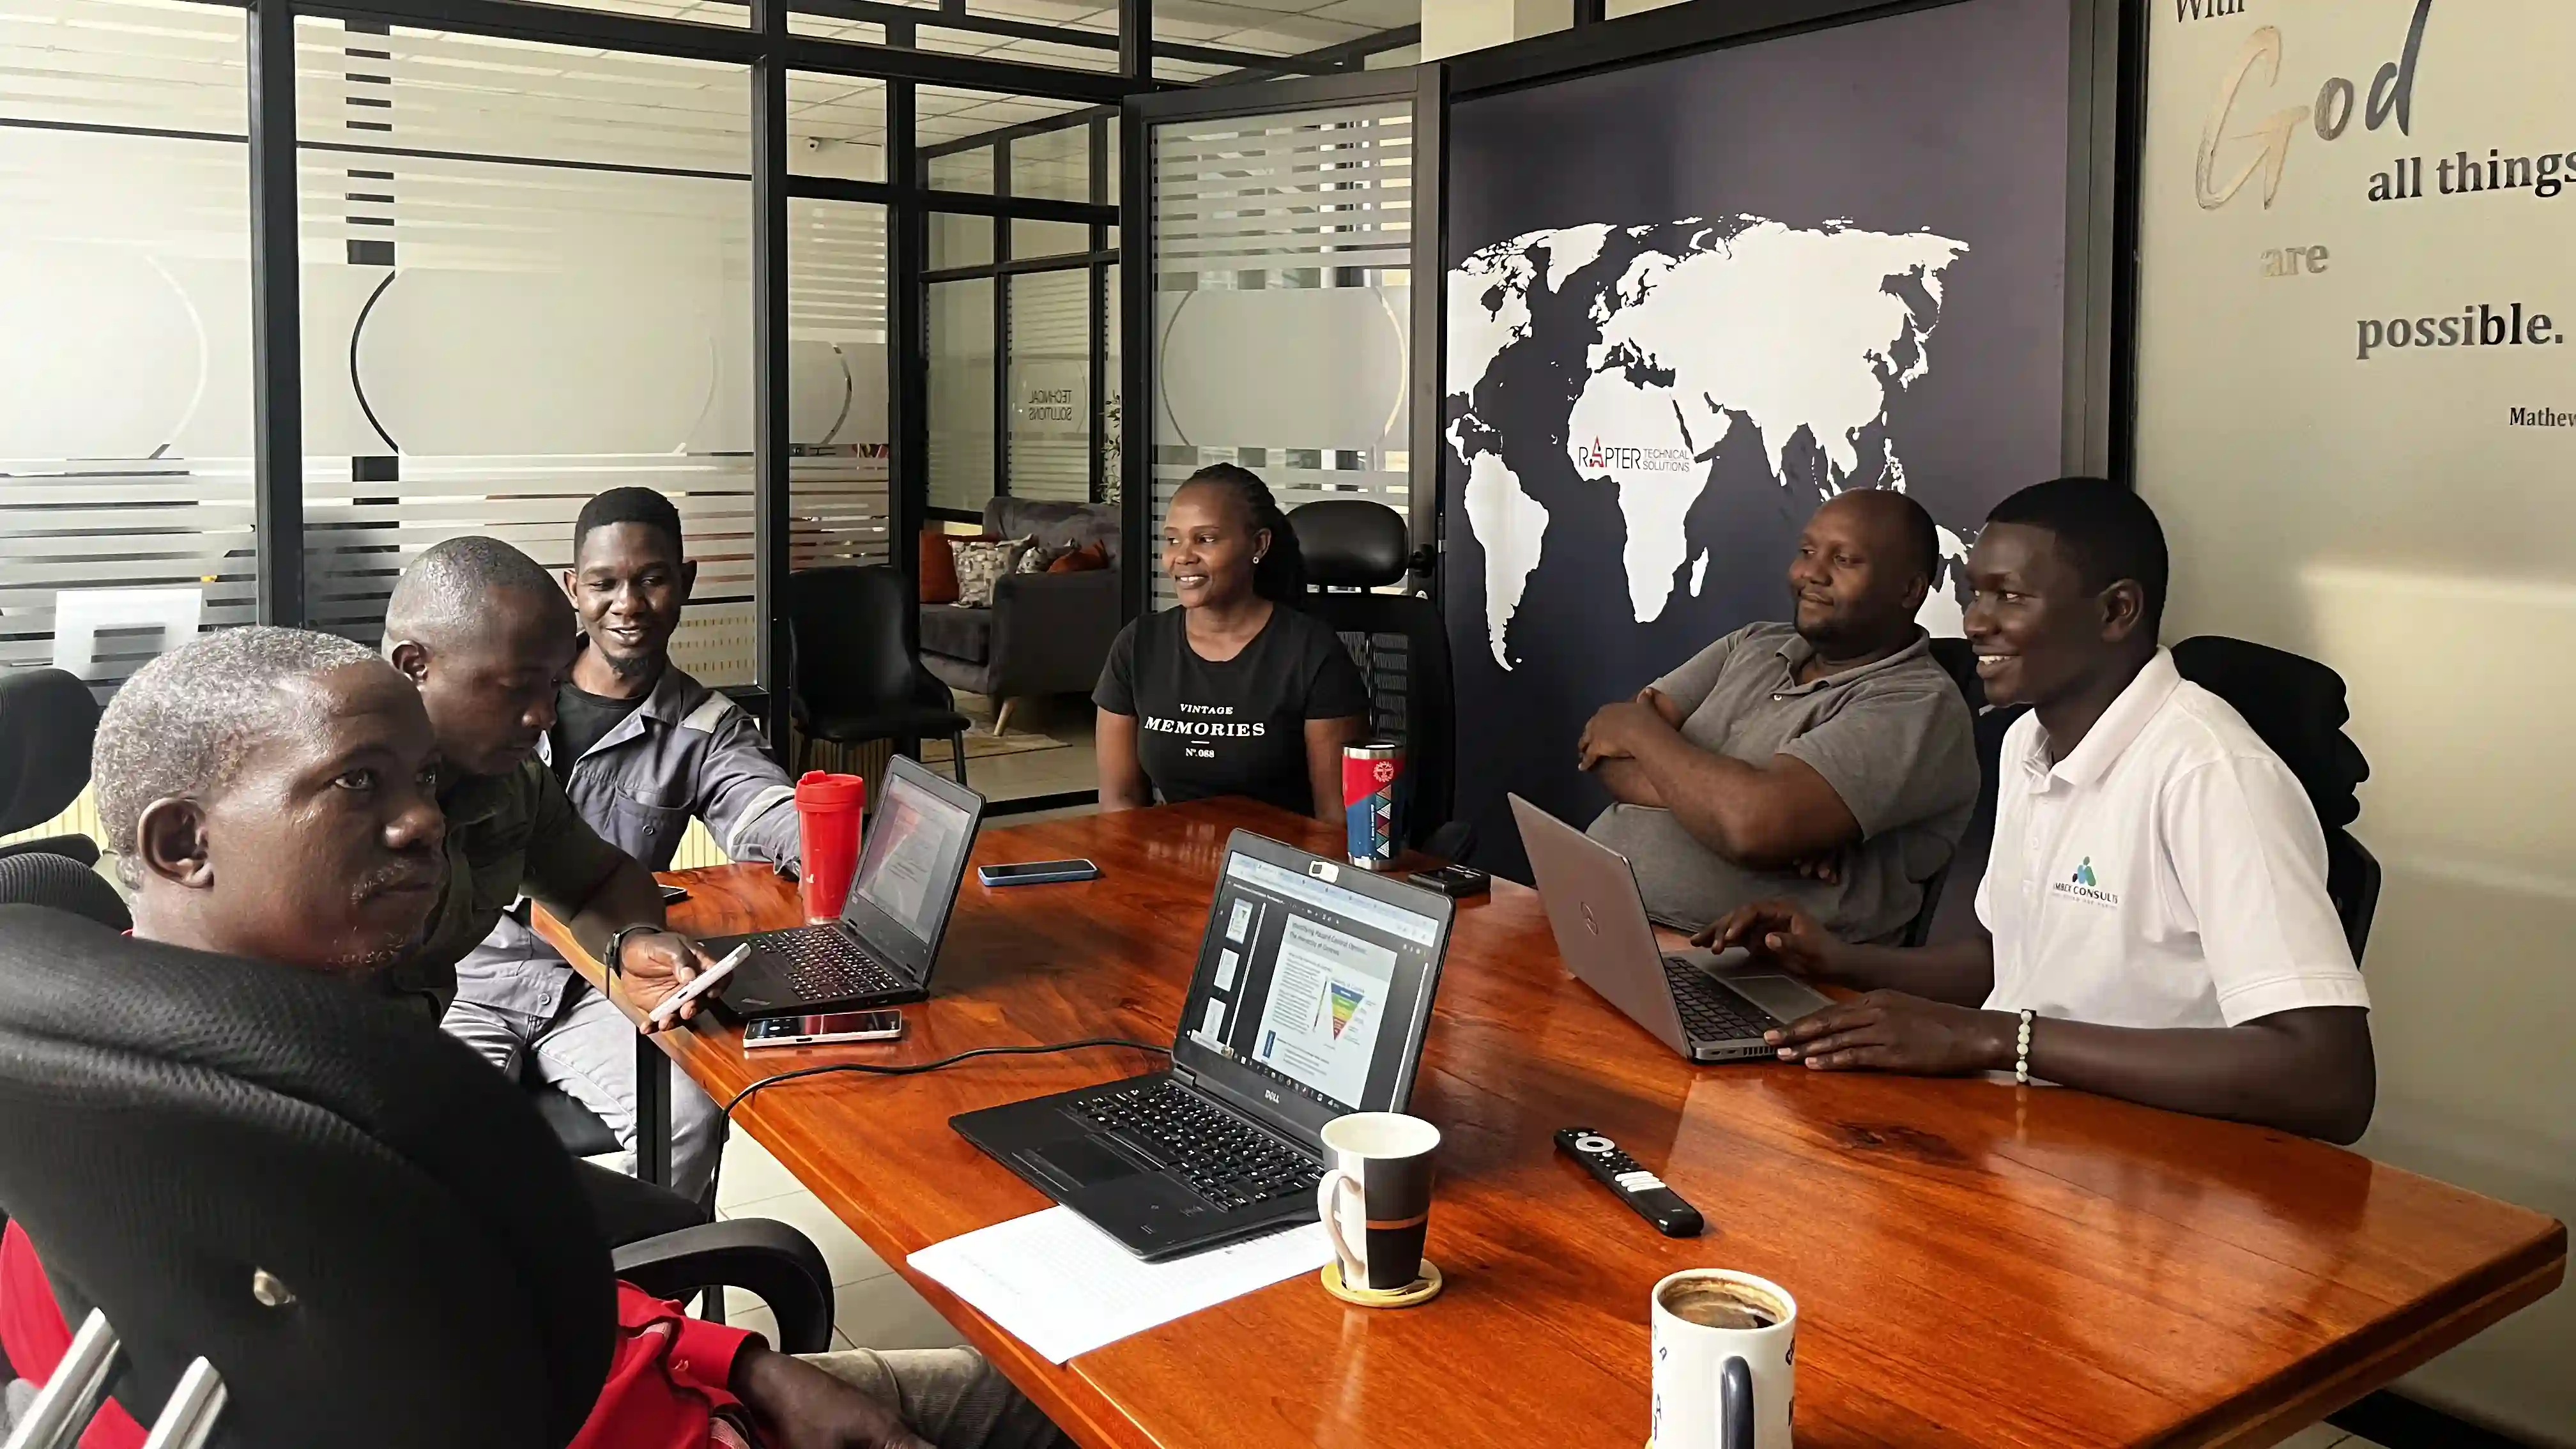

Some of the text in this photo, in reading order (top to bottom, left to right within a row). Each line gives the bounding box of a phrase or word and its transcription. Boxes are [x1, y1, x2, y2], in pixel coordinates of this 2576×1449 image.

[2195, 0, 2430, 210] God
[2368, 157, 2423, 202] all
[2260, 245, 2329, 277] are
[2356, 303, 2563, 360] possible.
[1579, 435, 1641, 470] RAPTER
[1643, 448, 1690, 460] TECHNICAL
[1643, 461, 1690, 472] SOLUTIONS
[1180, 703, 1234, 715] VINTAGE
[1144, 716, 1265, 737] MEMORIES
